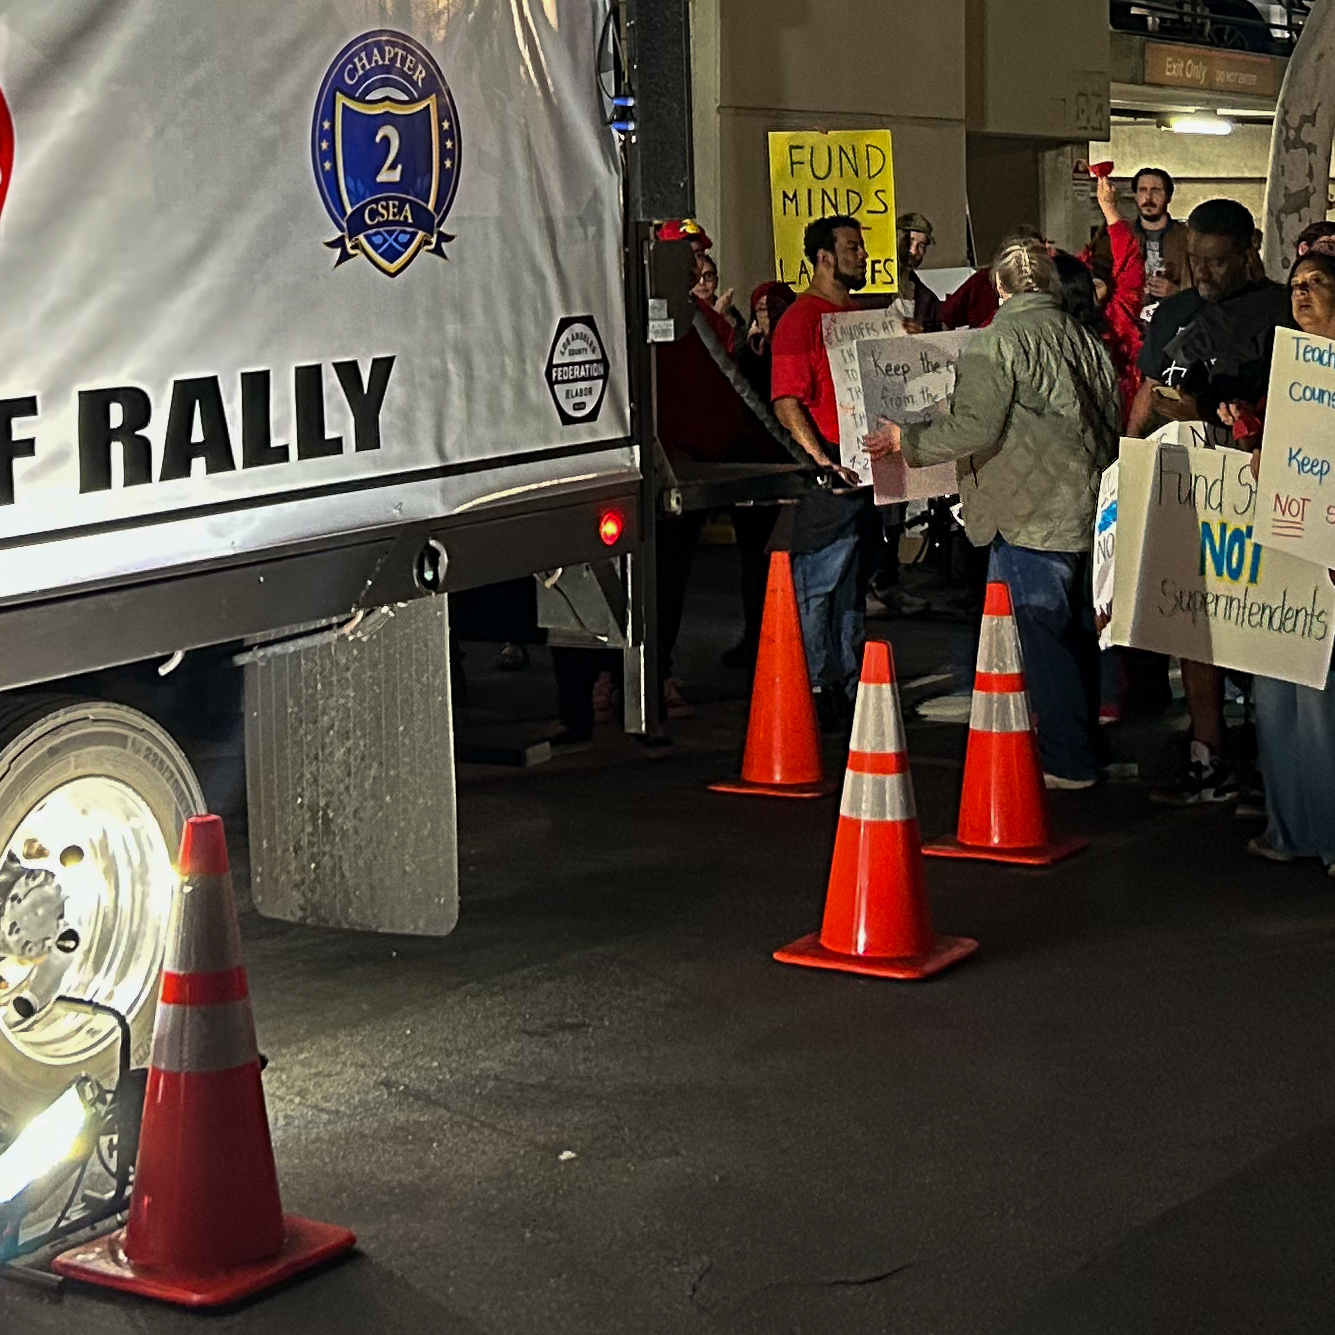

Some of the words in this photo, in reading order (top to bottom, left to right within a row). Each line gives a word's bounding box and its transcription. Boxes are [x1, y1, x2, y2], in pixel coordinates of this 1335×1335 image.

[343, 45, 426, 88] CHAPTER
[1166, 53, 1184, 77] Exit
[1186, 59, 1207, 85] Only
[375, 124, 402, 183] 2
[789, 143, 886, 181] FUND
[364, 200, 414, 226] CSEA
[782, 187, 889, 218] MINDS
[779, 258, 895, 287] LAFS
[834, 322, 880, 344] LAYOFFS
[882, 319, 896, 335] AT
[552, 362, 604, 383] FEDERATION
[872, 350, 911, 384] Keep
[920, 351, 942, 374] the
[880, 386, 915, 412] from
[77, 355, 397, 495] RALLY
[1287, 447, 1330, 486] Keep
[1156, 453, 1228, 516] Fund
[1273, 493, 1312, 523] NOT
[1199, 521, 1264, 585] NOT
[1157, 579, 1330, 642] Superintendents
